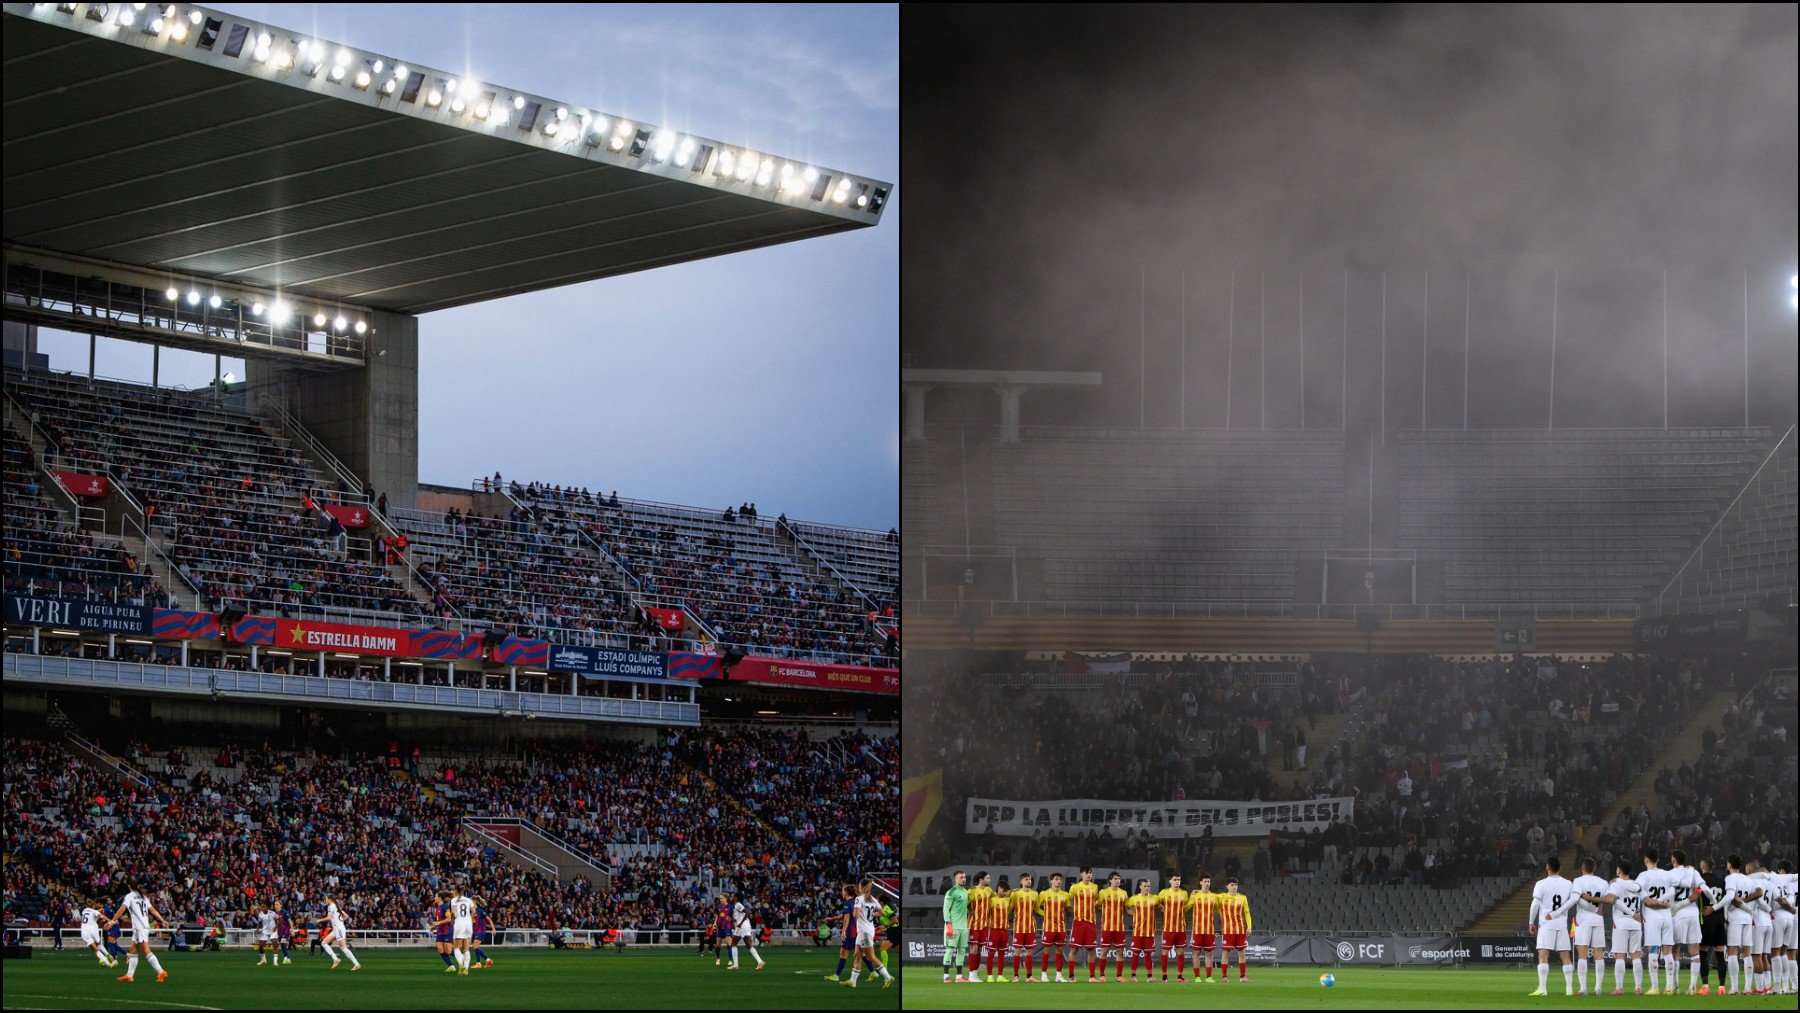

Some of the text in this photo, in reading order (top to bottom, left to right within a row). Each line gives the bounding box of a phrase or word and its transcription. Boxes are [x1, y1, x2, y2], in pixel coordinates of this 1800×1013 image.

[14, 597, 72, 625] VERI
[83, 604, 141, 619] AIGUA PURA
[80, 617, 143, 632] DEL PIRINEU
[307, 630, 397, 652] ESTRELLA DAMM
[598, 651, 661, 665] ESTADI OLÍMPIC
[594, 661, 618, 673] LLUÍS
[620, 663, 663, 676] COMPANYS
[778, 667, 817, 679] FC BARCELONA
[839, 673, 851, 683] QUE
[891, 677, 898, 686] FC
[1022, 807, 1052, 826] LA
[1186, 808, 1239, 827] DELS
[1246, 802, 1341, 825] POBLES!
[1552, 893, 1562, 912] 8
[459, 903, 467, 918] 8
[1358, 943, 1385, 959] FCF
[1422, 948, 1471, 961] esportcat
[1504, 951, 1535, 959] Catalunya
